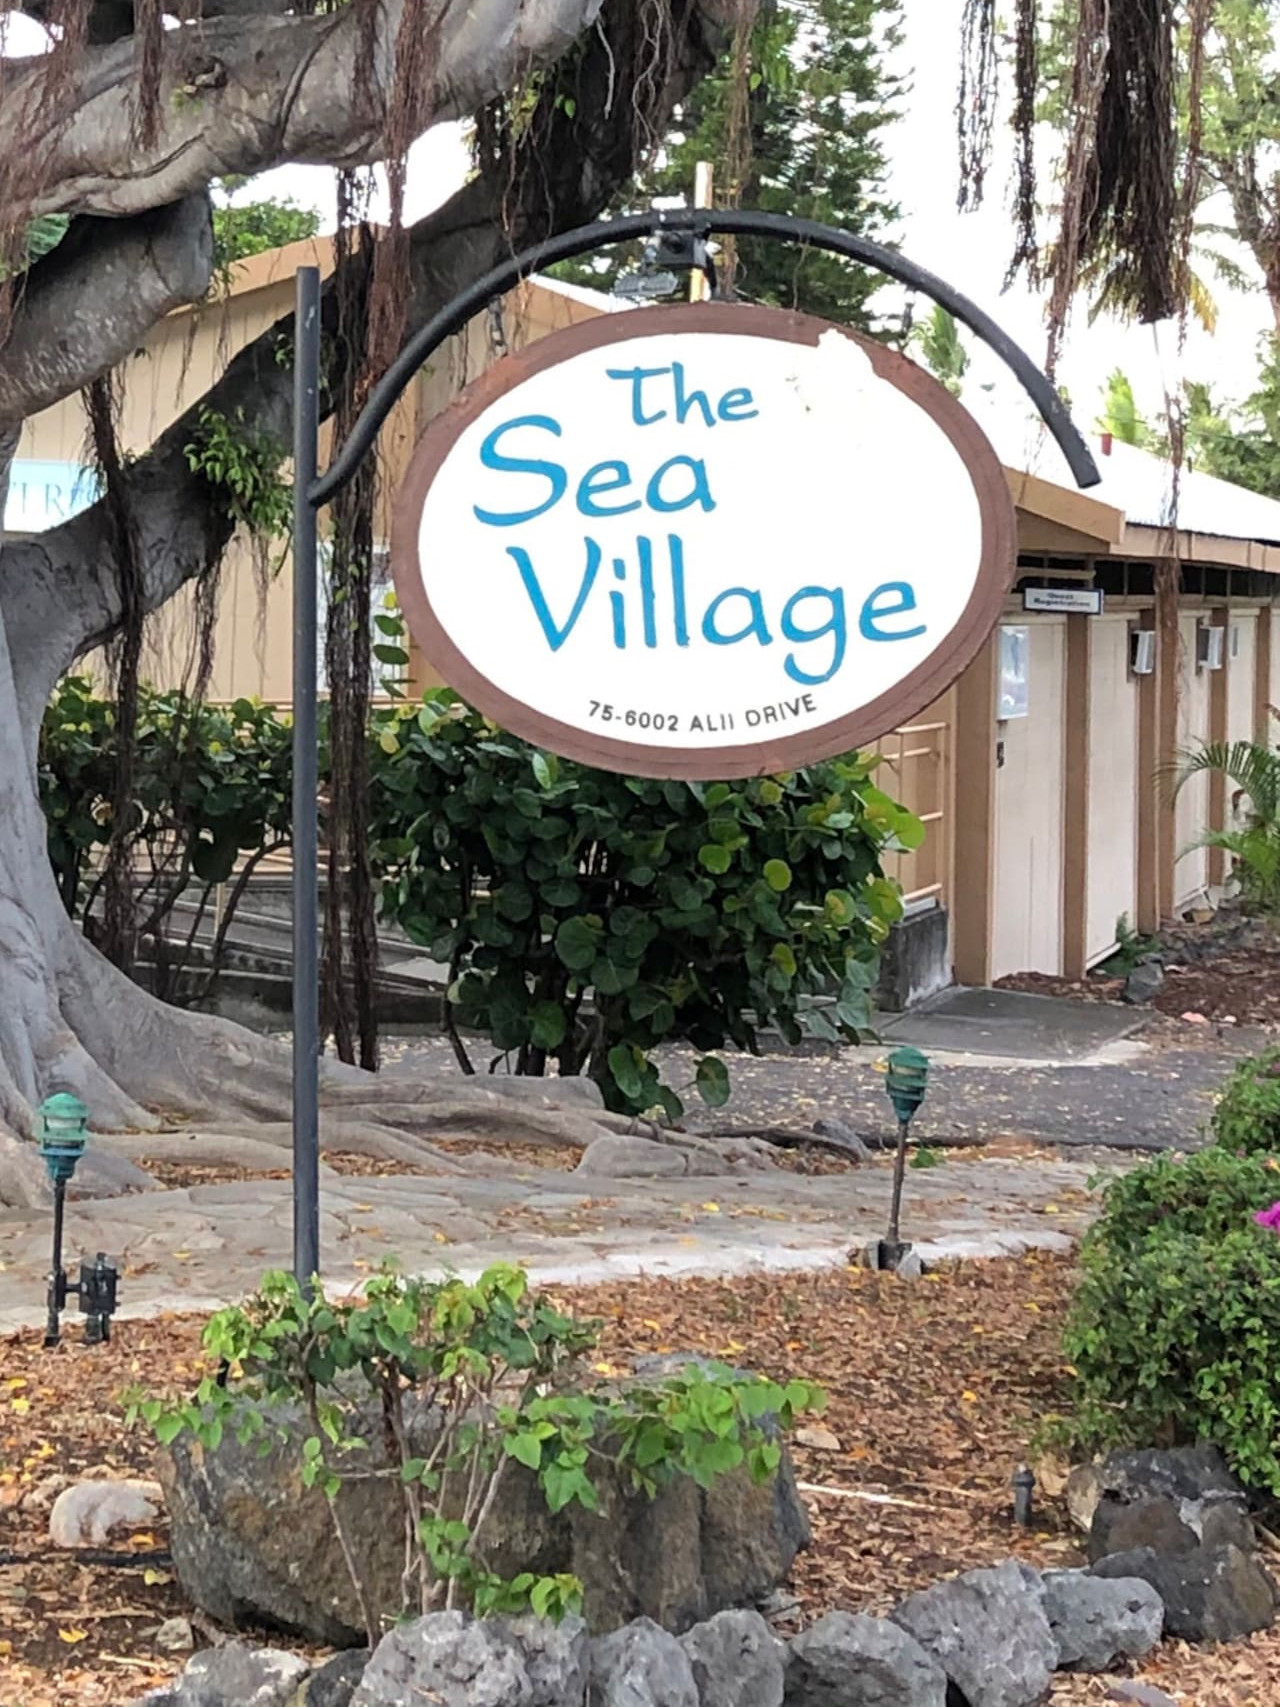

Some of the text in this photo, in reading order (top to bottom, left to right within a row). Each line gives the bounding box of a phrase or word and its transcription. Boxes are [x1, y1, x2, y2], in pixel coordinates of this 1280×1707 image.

[606, 360, 759, 428] The
[472, 414, 717, 527] Sea
[505, 533, 928, 686] Village
[588, 693, 818, 732] 75-6002 ALII DRIVE
